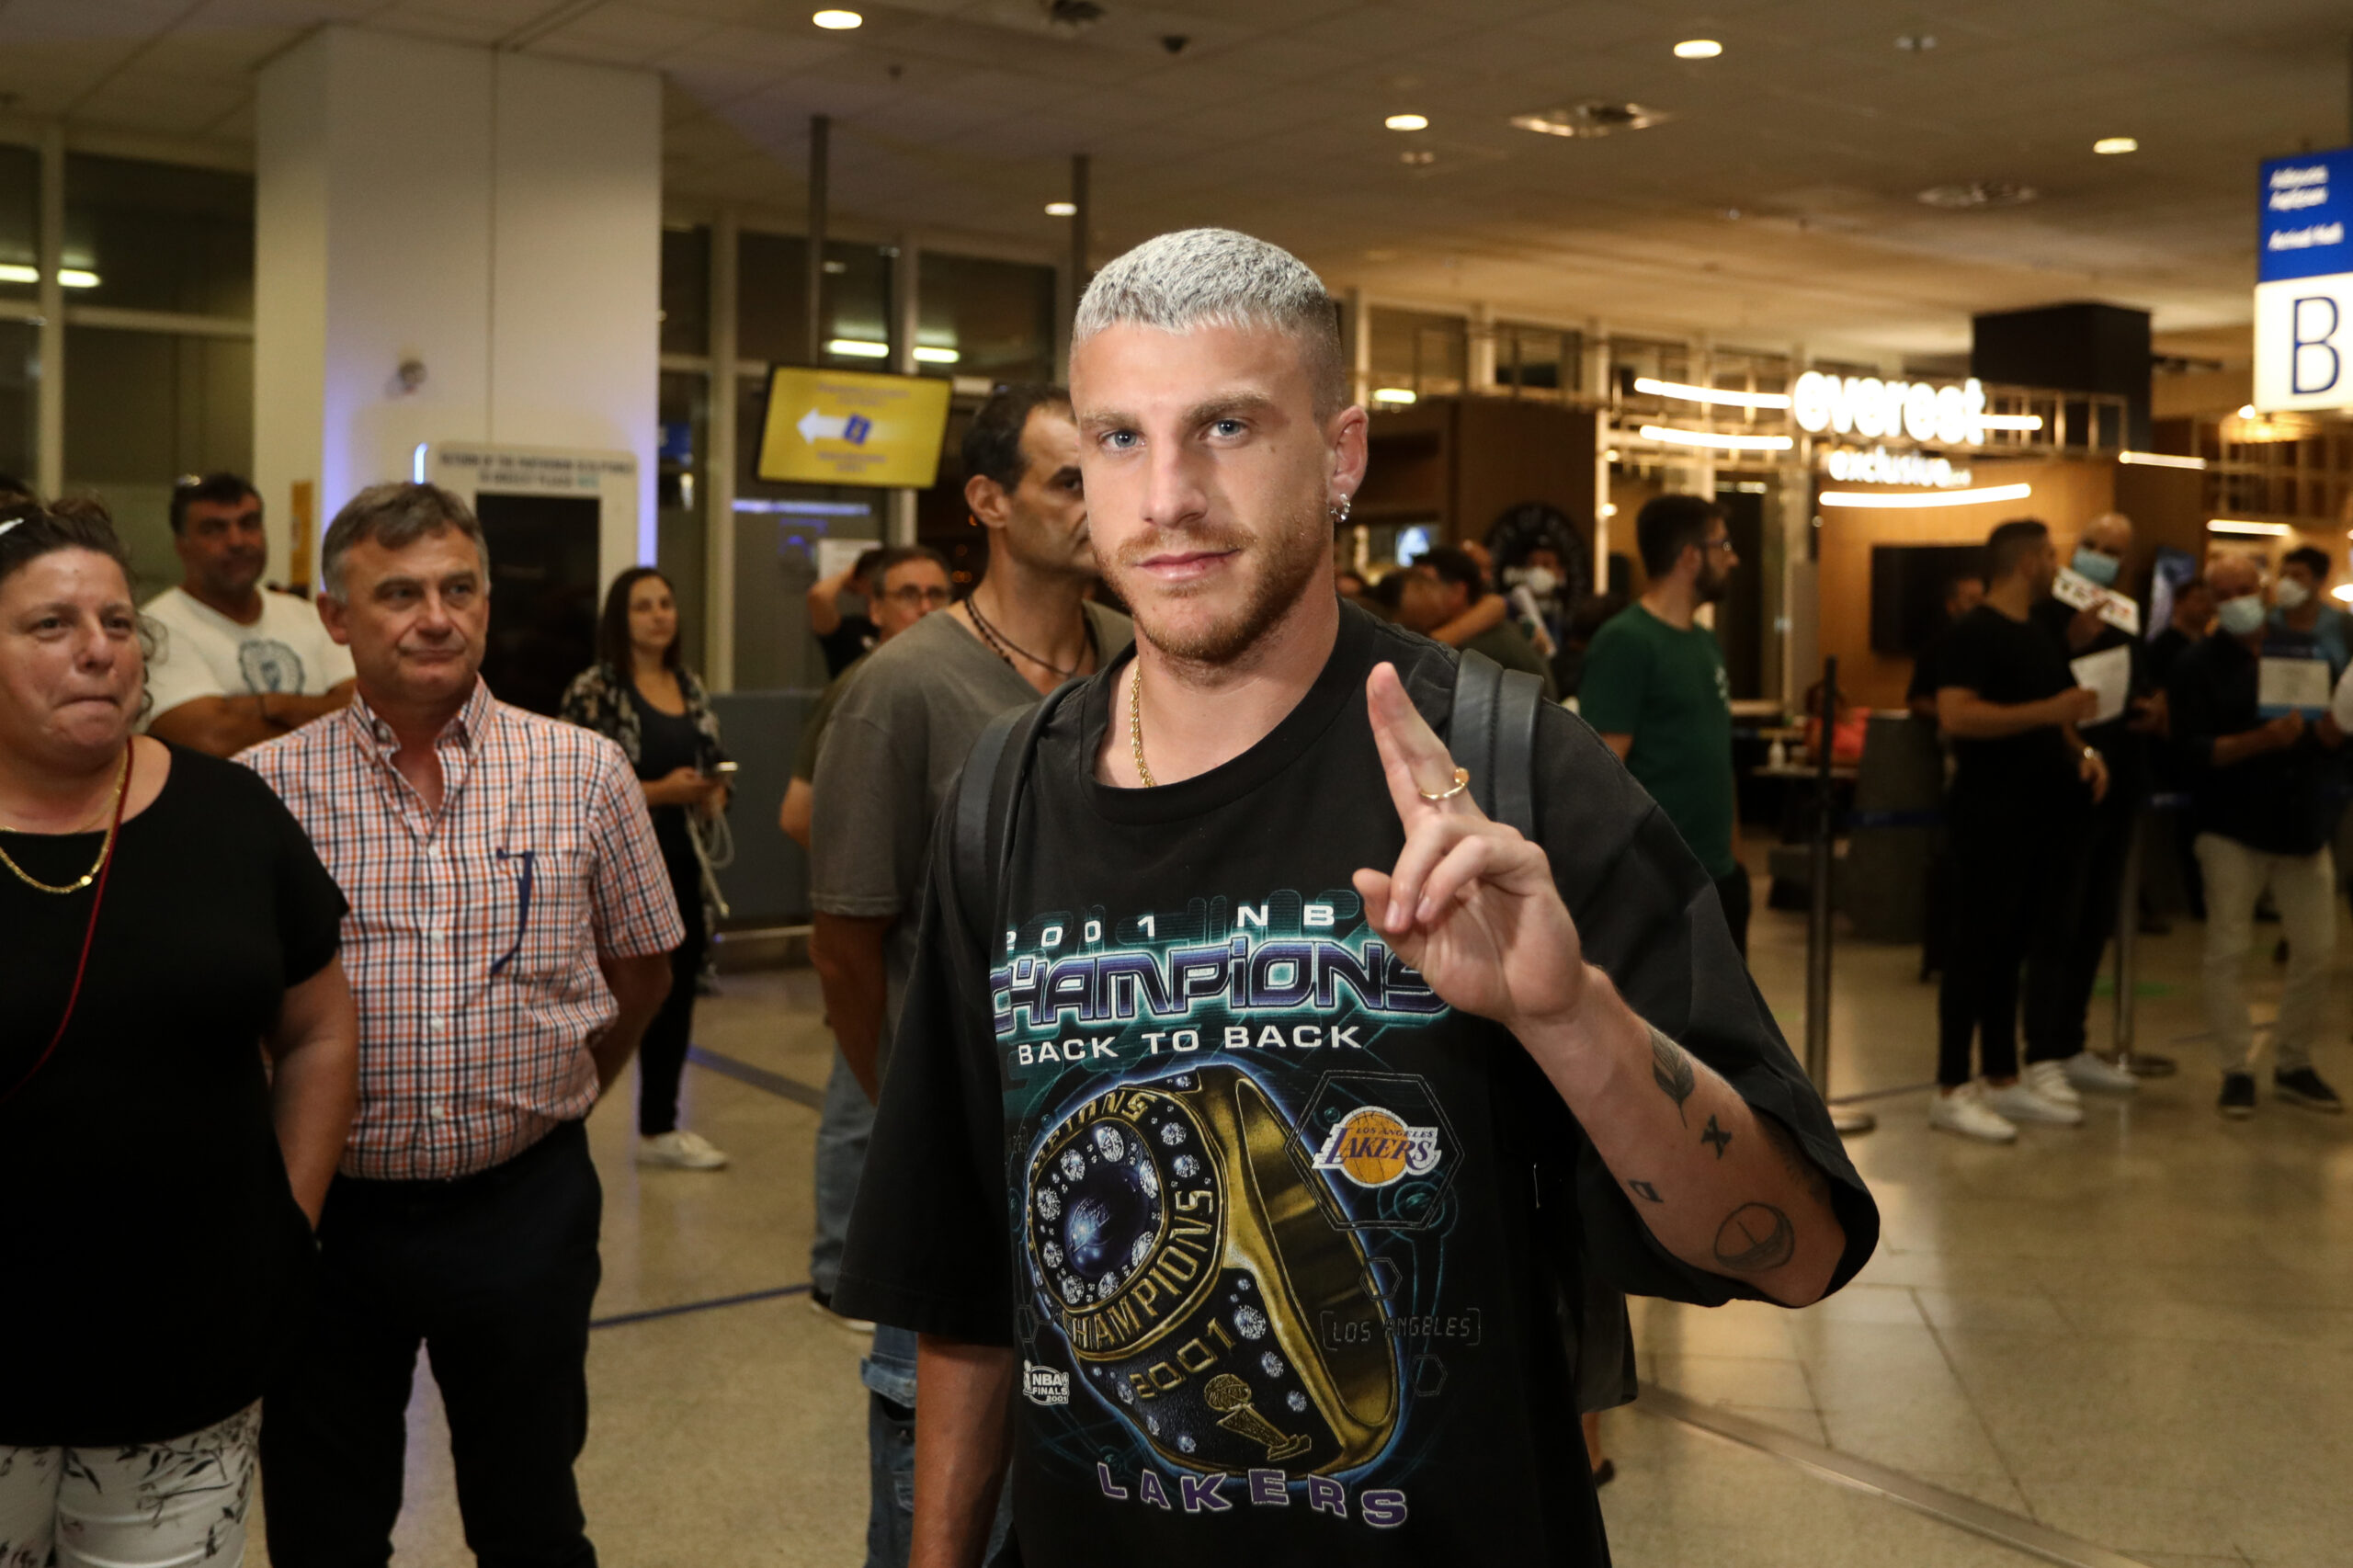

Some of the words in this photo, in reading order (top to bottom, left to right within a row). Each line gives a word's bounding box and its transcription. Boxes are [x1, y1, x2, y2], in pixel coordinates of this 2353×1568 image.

[2292, 296, 2340, 395] B
[1236, 903, 1336, 928] NB
[1017, 1036, 1119, 1066] BACK
[1141, 1029, 1199, 1055] TO
[1223, 1025, 1363, 1050] BACK
[1318, 1127, 1437, 1172] LAKERS
[1355, 1127, 1376, 1135] LOS
[1382, 1129, 1435, 1139] ANGELES
[1332, 1321, 1371, 1343] LOS
[1129, 1317, 1236, 1399] 2001
[1032, 1373, 1063, 1386] NBA
[1032, 1386, 1068, 1396] FINALS
[1097, 1461, 1409, 1529] LAKERS
